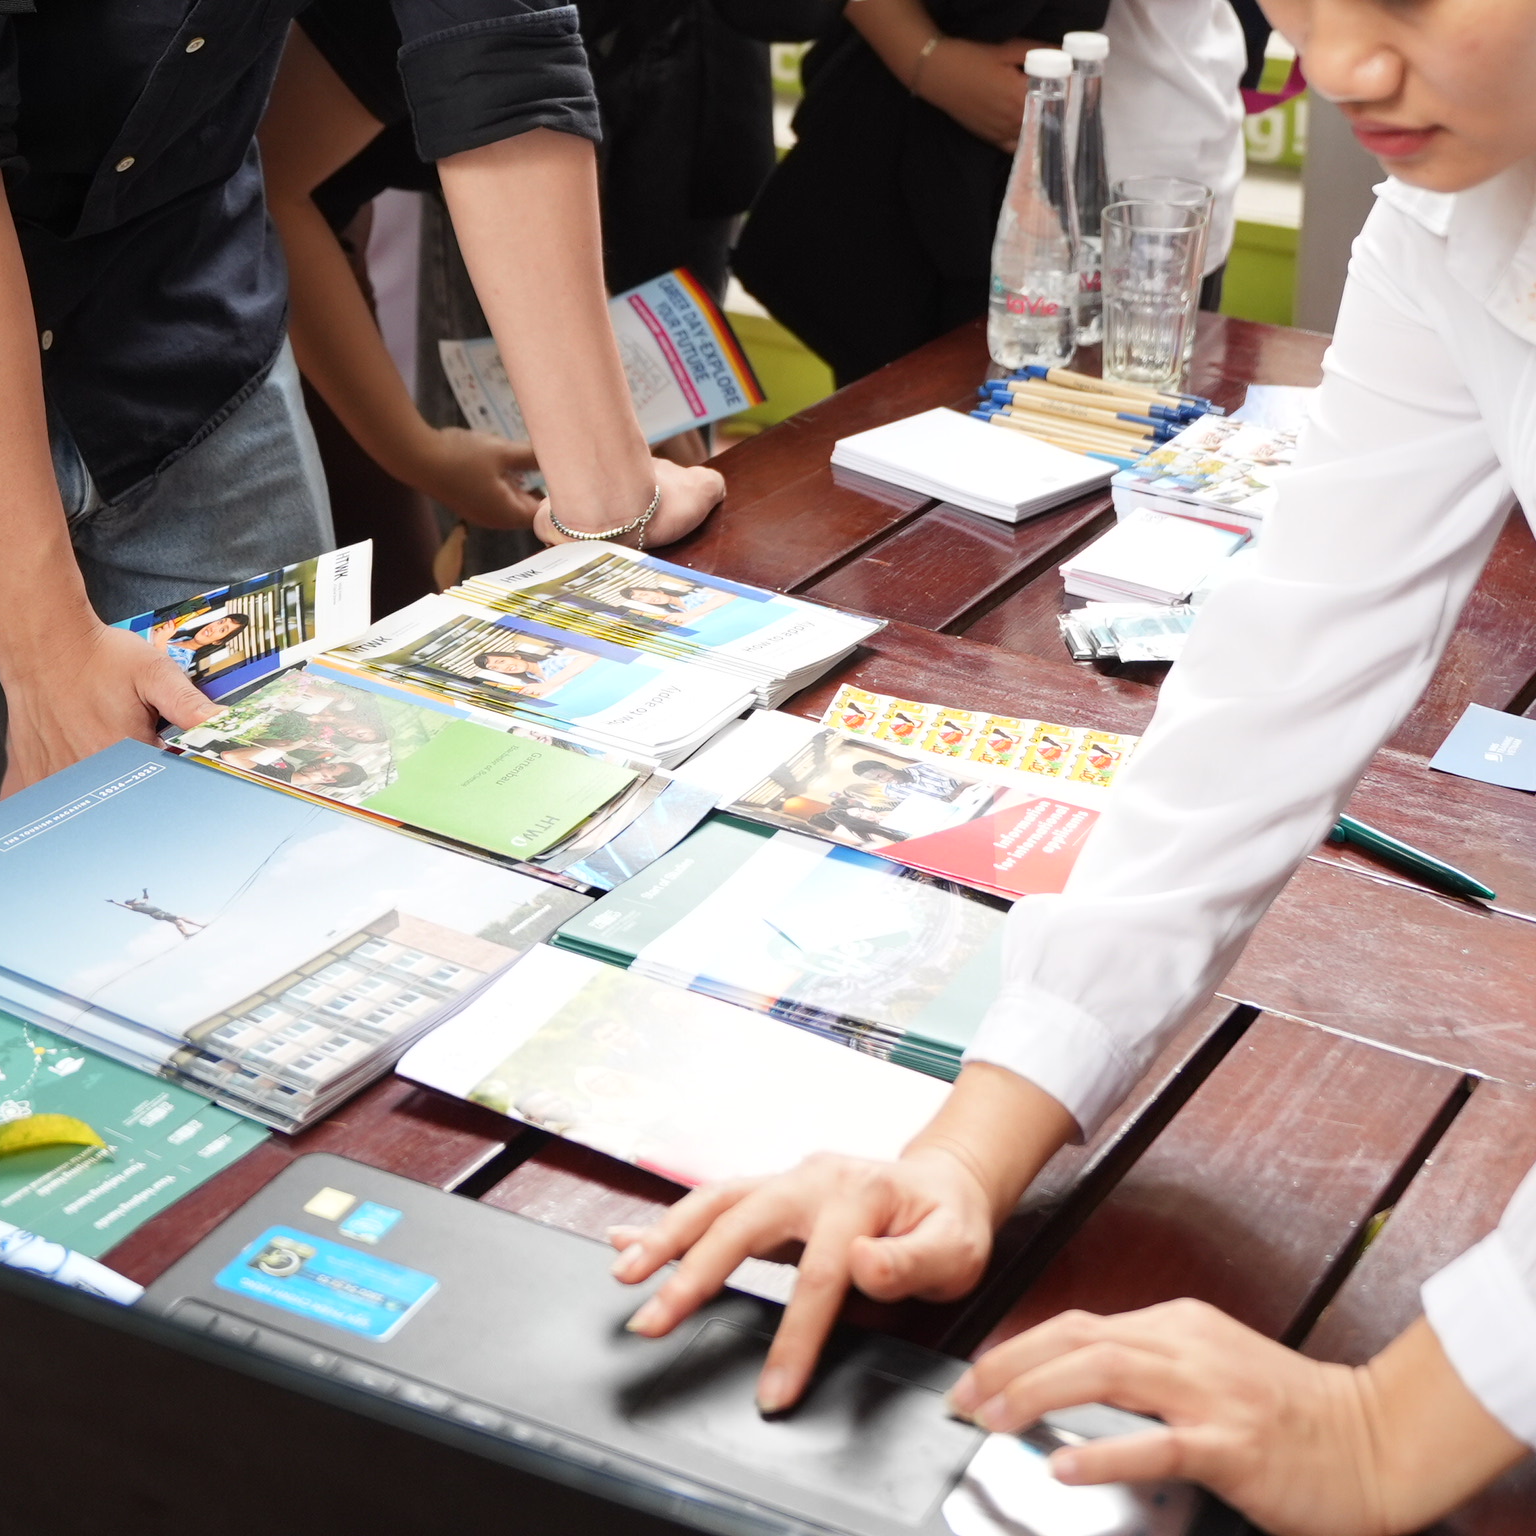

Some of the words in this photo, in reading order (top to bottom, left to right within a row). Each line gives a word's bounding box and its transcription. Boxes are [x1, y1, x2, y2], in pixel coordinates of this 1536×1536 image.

[674, 329, 710, 384] FUTURE
[335, 551, 350, 581] HTWK
[500, 568, 543, 584] HTWK
[345, 635, 392, 655] HTWK
[744, 639, 771, 653] How
[784, 620, 816, 639] apply
[630, 705, 648, 716] to
[648, 684, 682, 709] apply
[496, 752, 542, 785] Gartenbau
[3, 835, 20, 847] THE
[19, 819, 53, 838] TOURISM
[53, 799, 92, 821] MAGAZINE
[993, 800, 1051, 849] Information
[993, 857, 1016, 871] for
[1007, 804, 1070, 858] international
[1042, 810, 1089, 854] applicants
